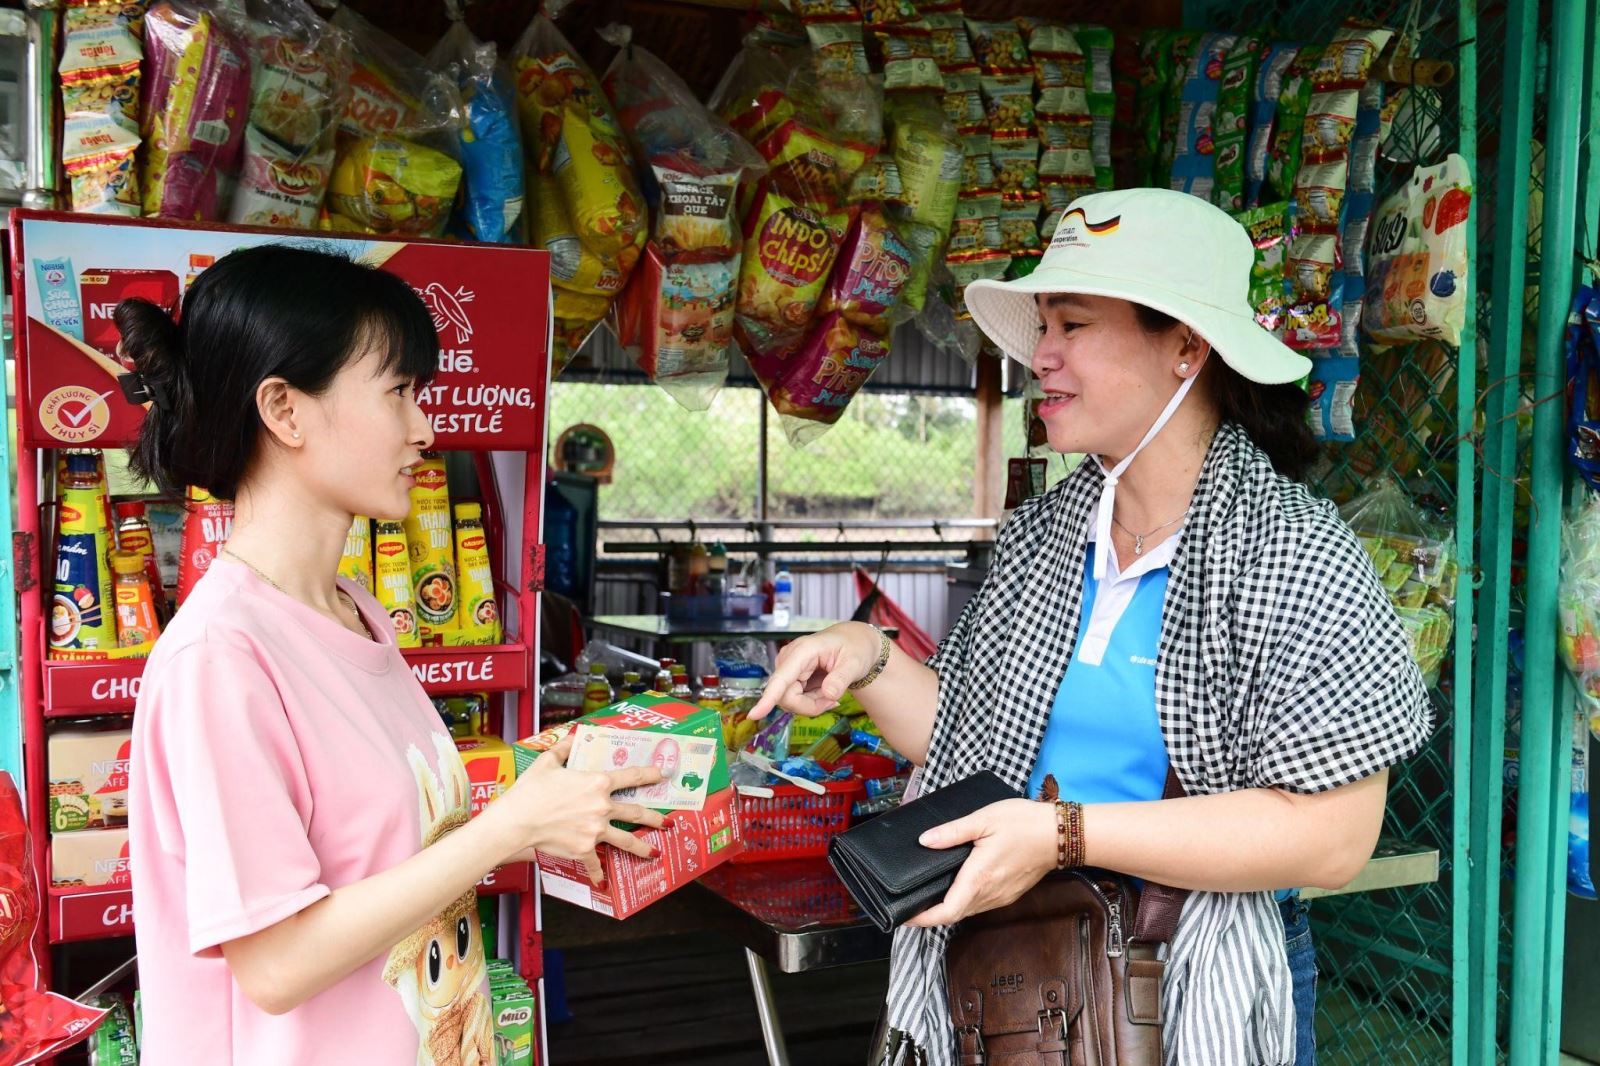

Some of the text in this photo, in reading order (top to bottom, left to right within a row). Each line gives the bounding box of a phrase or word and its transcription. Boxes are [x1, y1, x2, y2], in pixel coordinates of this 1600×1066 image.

[684, 205, 708, 215] QUE
[772, 211, 828, 249] INDO
[451, 383, 536, 411] LƯỢNG,
[412, 655, 494, 684] NESTLÉ
[55, 810, 69, 830] 6
[991, 972, 1024, 992] Jeep
[501, 1011, 528, 1023] MILO
